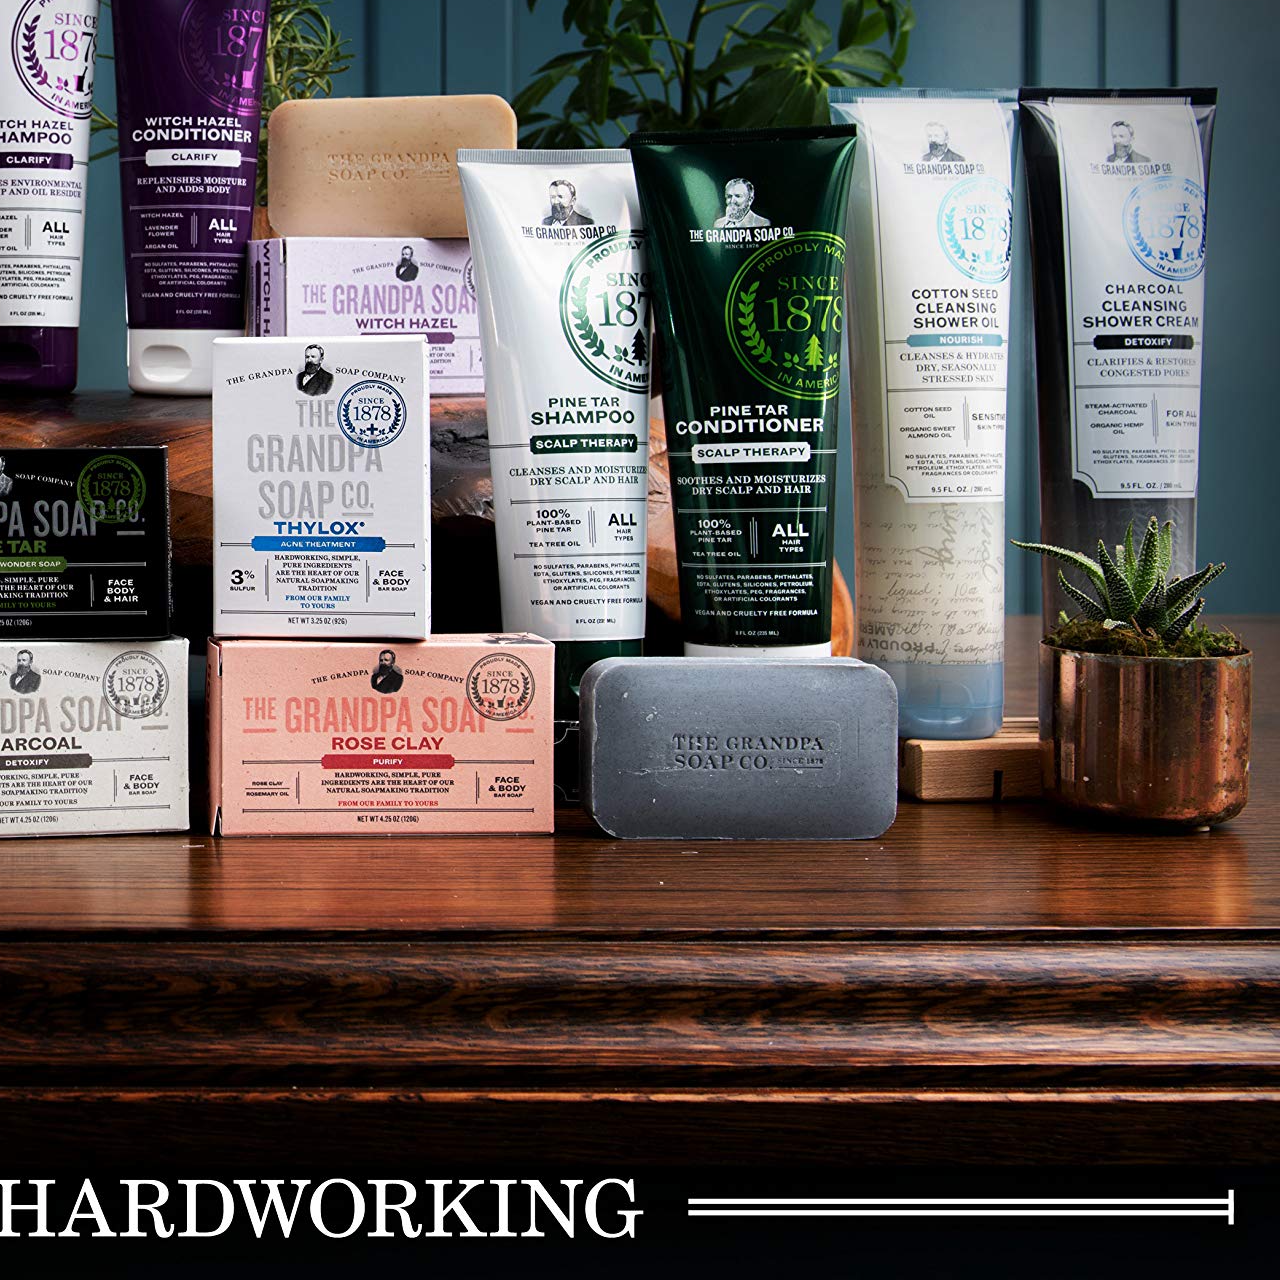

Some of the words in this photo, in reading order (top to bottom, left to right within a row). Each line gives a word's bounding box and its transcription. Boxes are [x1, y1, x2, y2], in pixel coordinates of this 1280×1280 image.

[31, 119, 74, 131] HAZEL
[145, 116, 193, 128] WITCH
[197, 116, 242, 128] HAZEL
[133, 128, 252, 143] CONDITIONER
[6, 155, 53, 165] CLARIFY
[171, 152, 218, 162] CLARIFY
[209, 219, 237, 231] ALL
[911, 288, 969, 300] COTTON
[971, 288, 999, 299] SEED
[1105, 283, 1184, 295] CHARCOAL
[915, 302, 997, 315] CLEANSING
[1102, 300, 1186, 312] CLEANSING
[355, 317, 405, 330] WITCH
[409, 317, 458, 329] HAZEL
[913, 316, 978, 329] SHOWER
[981, 317, 999, 329] OIL
[1083, 316, 1152, 328] SHOWER
[1155, 315, 1199, 328] CREAM
[939, 335, 984, 346] NOURISH
[1124, 337, 1173, 347] DETOXIFY
[548, 397, 588, 409] PINE
[590, 396, 620, 408] TAR
[709, 404, 752, 417] PINE
[754, 404, 789, 416] TAR
[531, 410, 634, 425] SHAMPOO
[676, 418, 824, 435] CONDITIONER
[535, 439, 579, 450] SCALP
[580, 438, 635, 450] THERAPY
[697, 448, 741, 458] SCALP
[742, 447, 806, 457] THERAPY
[7, 540, 46, 553] TAR
[280, 540, 304, 548] ACNE
[37, 560, 61, 568] SOAP
[231, 570, 254, 585] 3%
[332, 737, 386, 750] ROSE
[392, 737, 443, 750] CLAY
[672, 734, 718, 751] THE
[725, 736, 824, 751] GRANDPA
[5, 758, 50, 767] DETOXIFY
[372, 758, 404, 766] PURIFY
[675, 754, 733, 769] SOAP
[739, 754, 772, 770] CO.
